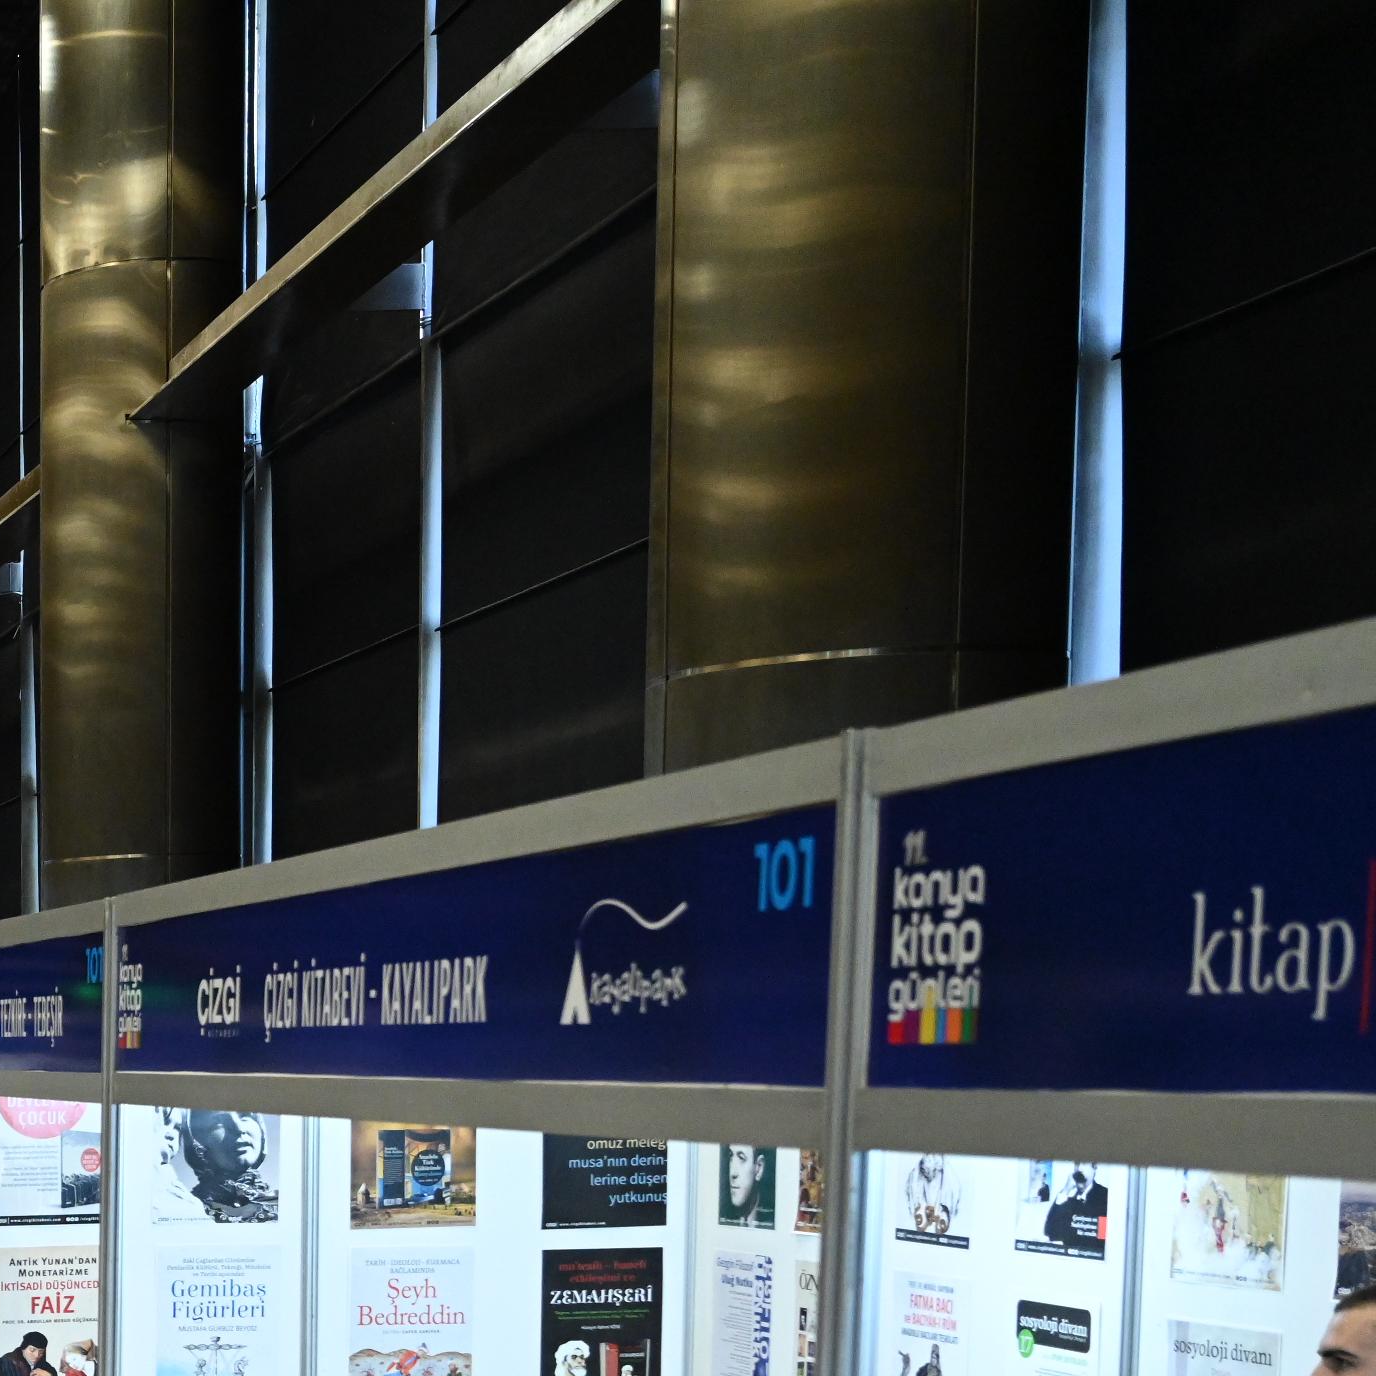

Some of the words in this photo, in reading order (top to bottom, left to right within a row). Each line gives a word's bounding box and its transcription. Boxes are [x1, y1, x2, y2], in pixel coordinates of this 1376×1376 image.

[753, 836, 816, 913] 101
[893, 865, 985, 919] konya
[891, 913, 982, 973] kitap
[1186, 884, 1356, 1021] kitap
[119, 961, 143, 987] konya
[119, 984, 142, 1013] kitap
[197, 964, 241, 1037] ÇİZGİ
[263, 960, 299, 1043] ÇİZGİ
[301, 952, 366, 1028] KİTABEVİ
[381, 954, 489, 1026] KAYALIPARK
[887, 967, 981, 1022] günleri
[0, 989, 27, 1038] TEZKİRE
[33, 985, 64, 1048] TEBEŞİR
[18, 1110, 67, 1129] ÇOCUK
[587, 1139, 624, 1150] omuz
[568, 1155, 628, 1169] musa'nın
[590, 1173, 627, 1186] lerine
[629, 1172, 667, 1187] düşen
[609, 1191, 667, 1207] yutkunuş
[9, 1257, 38, 1266] ANTİK
[18, 1268, 89, 1277] MONETARİZME
[0, 1279, 43, 1292] İKTİSADİ
[45, 1279, 100, 1291] DÜŞÜNCED
[171, 1279, 266, 1301] Gemibaş
[387, 1278, 437, 1306] Şeyh
[31, 1291, 75, 1315] FAİZ
[172, 1299, 265, 1321] Figürleri
[356, 1304, 466, 1326] Bedreddin
[1019, 1314, 1058, 1336] sosyoloji
[1173, 1339, 1228, 1362] sosyoloji
[1230, 1343, 1272, 1366] divanı
